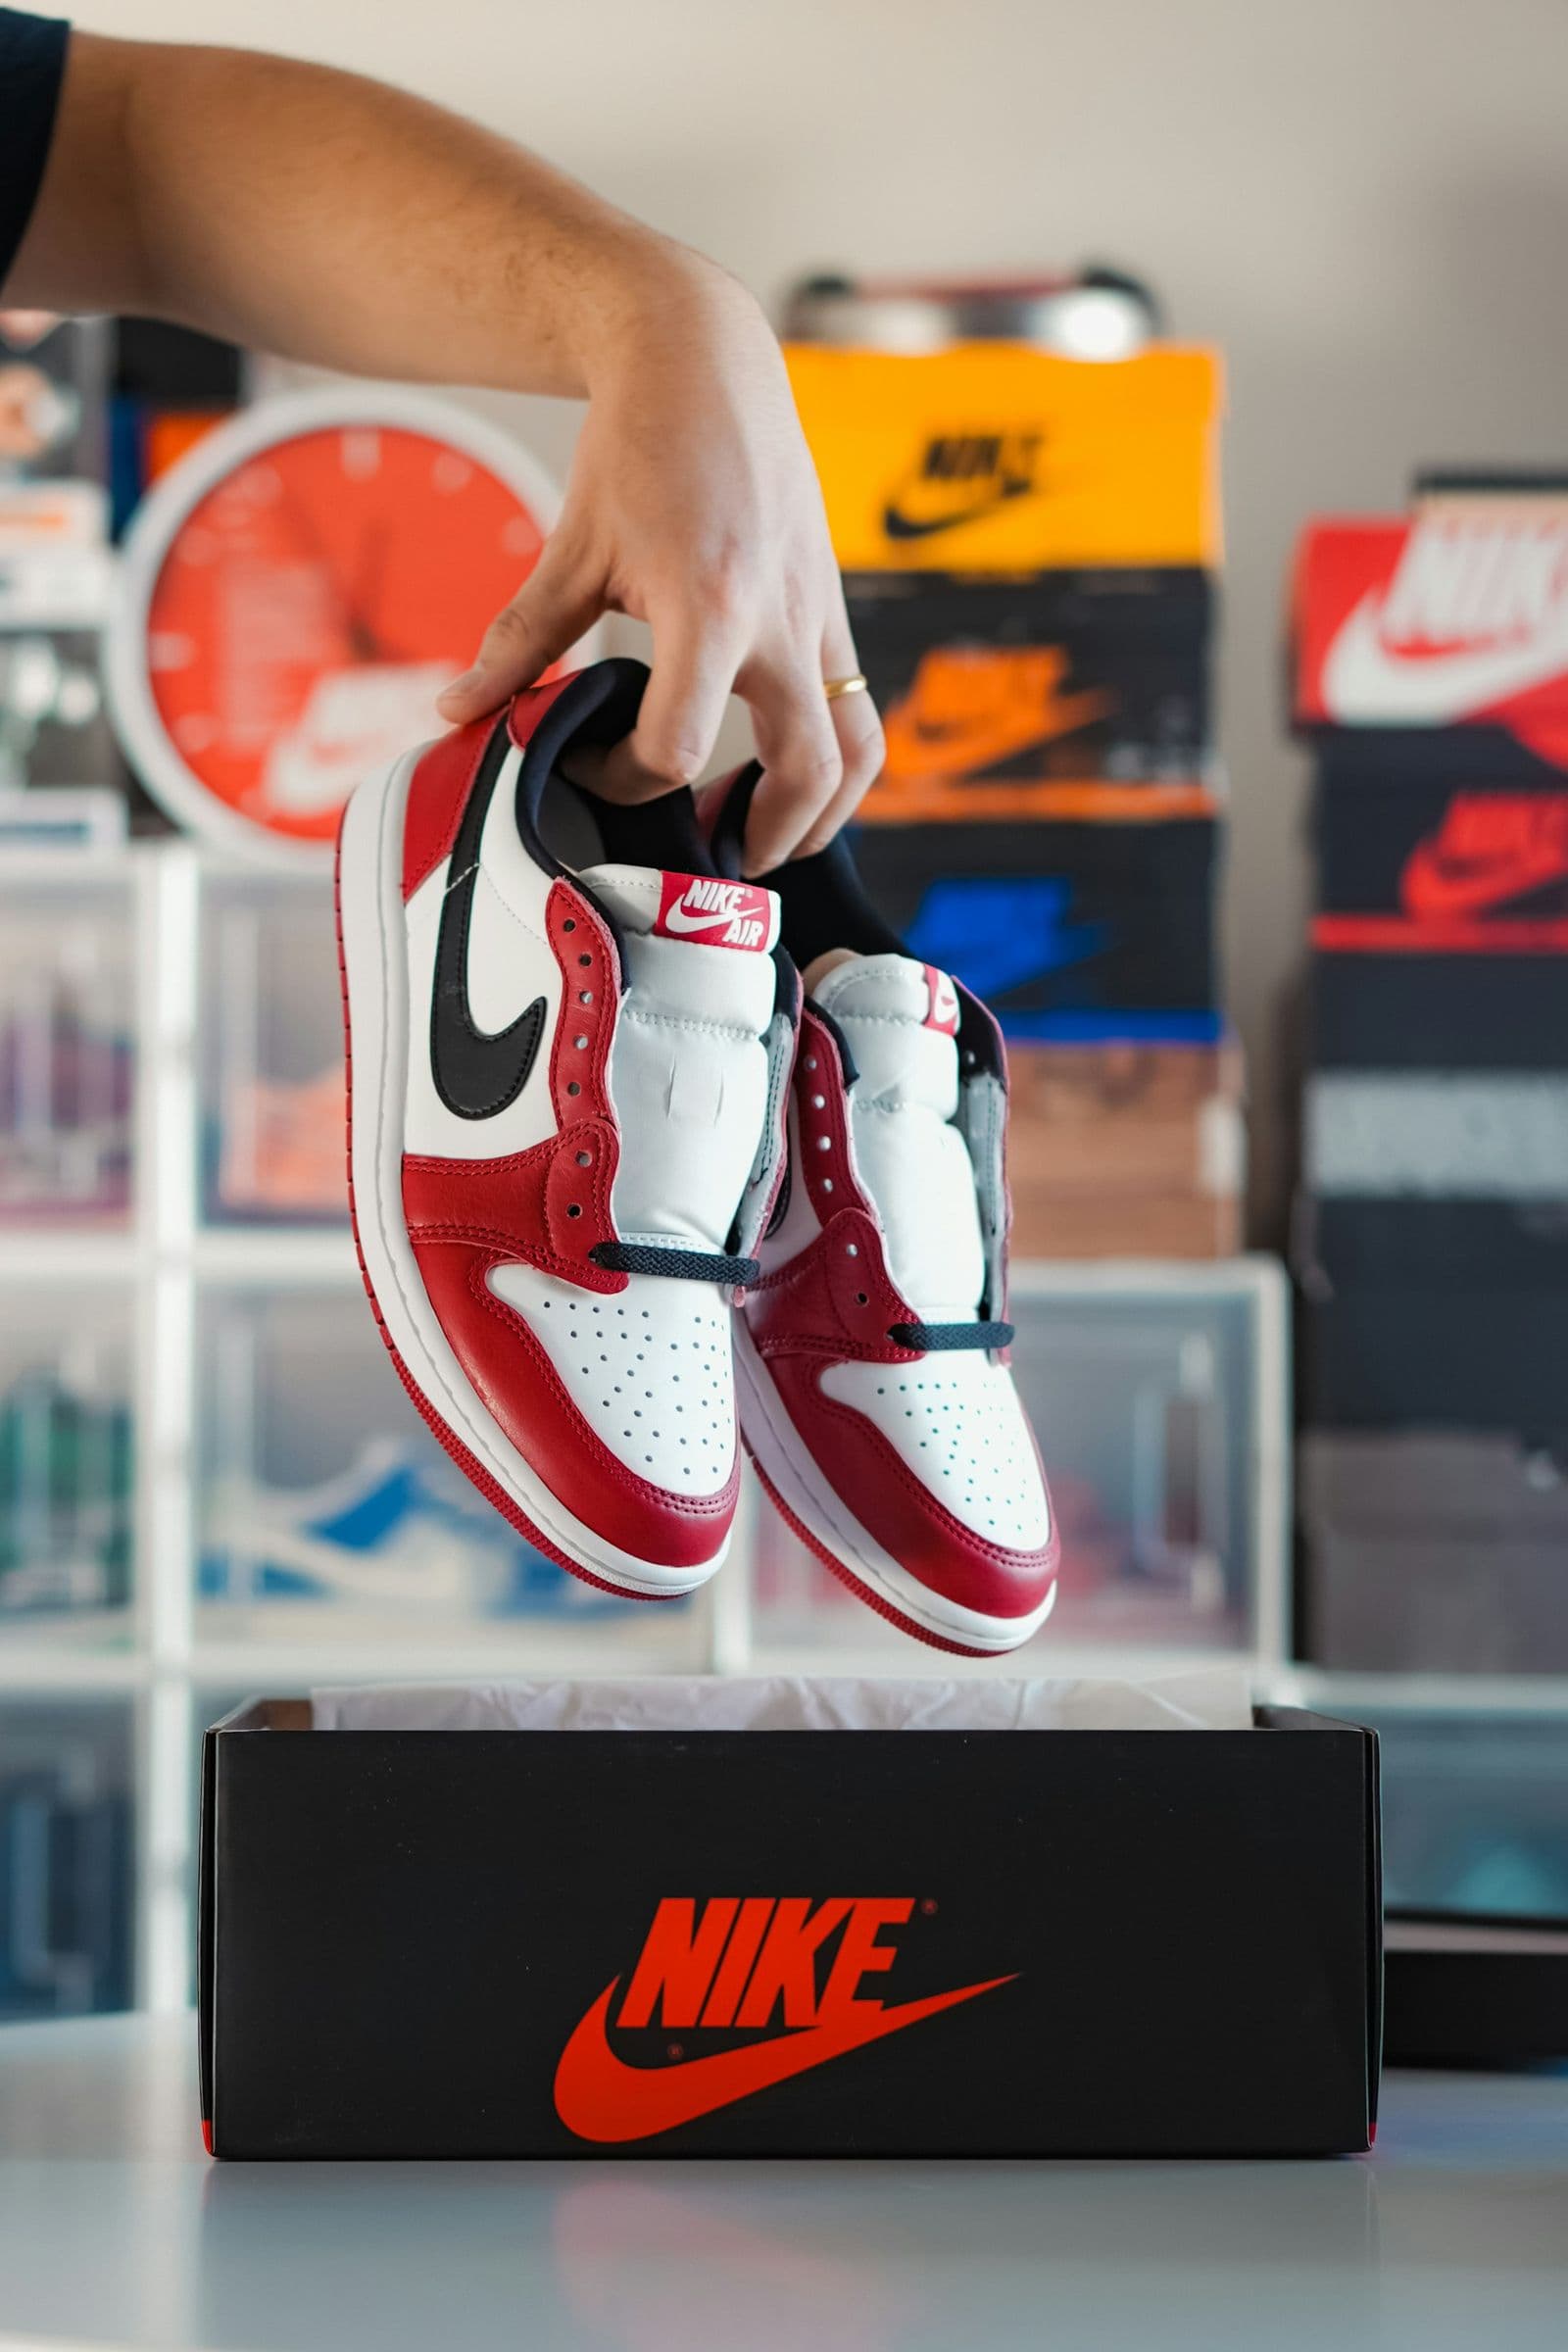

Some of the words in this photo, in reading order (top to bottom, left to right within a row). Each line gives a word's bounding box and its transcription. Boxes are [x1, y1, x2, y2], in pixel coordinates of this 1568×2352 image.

[1379, 517, 1568, 639] NIK
[682, 879, 745, 914] NIKE
[722, 917, 764, 948] AIR
[615, 1897, 915, 2028] NIKE
